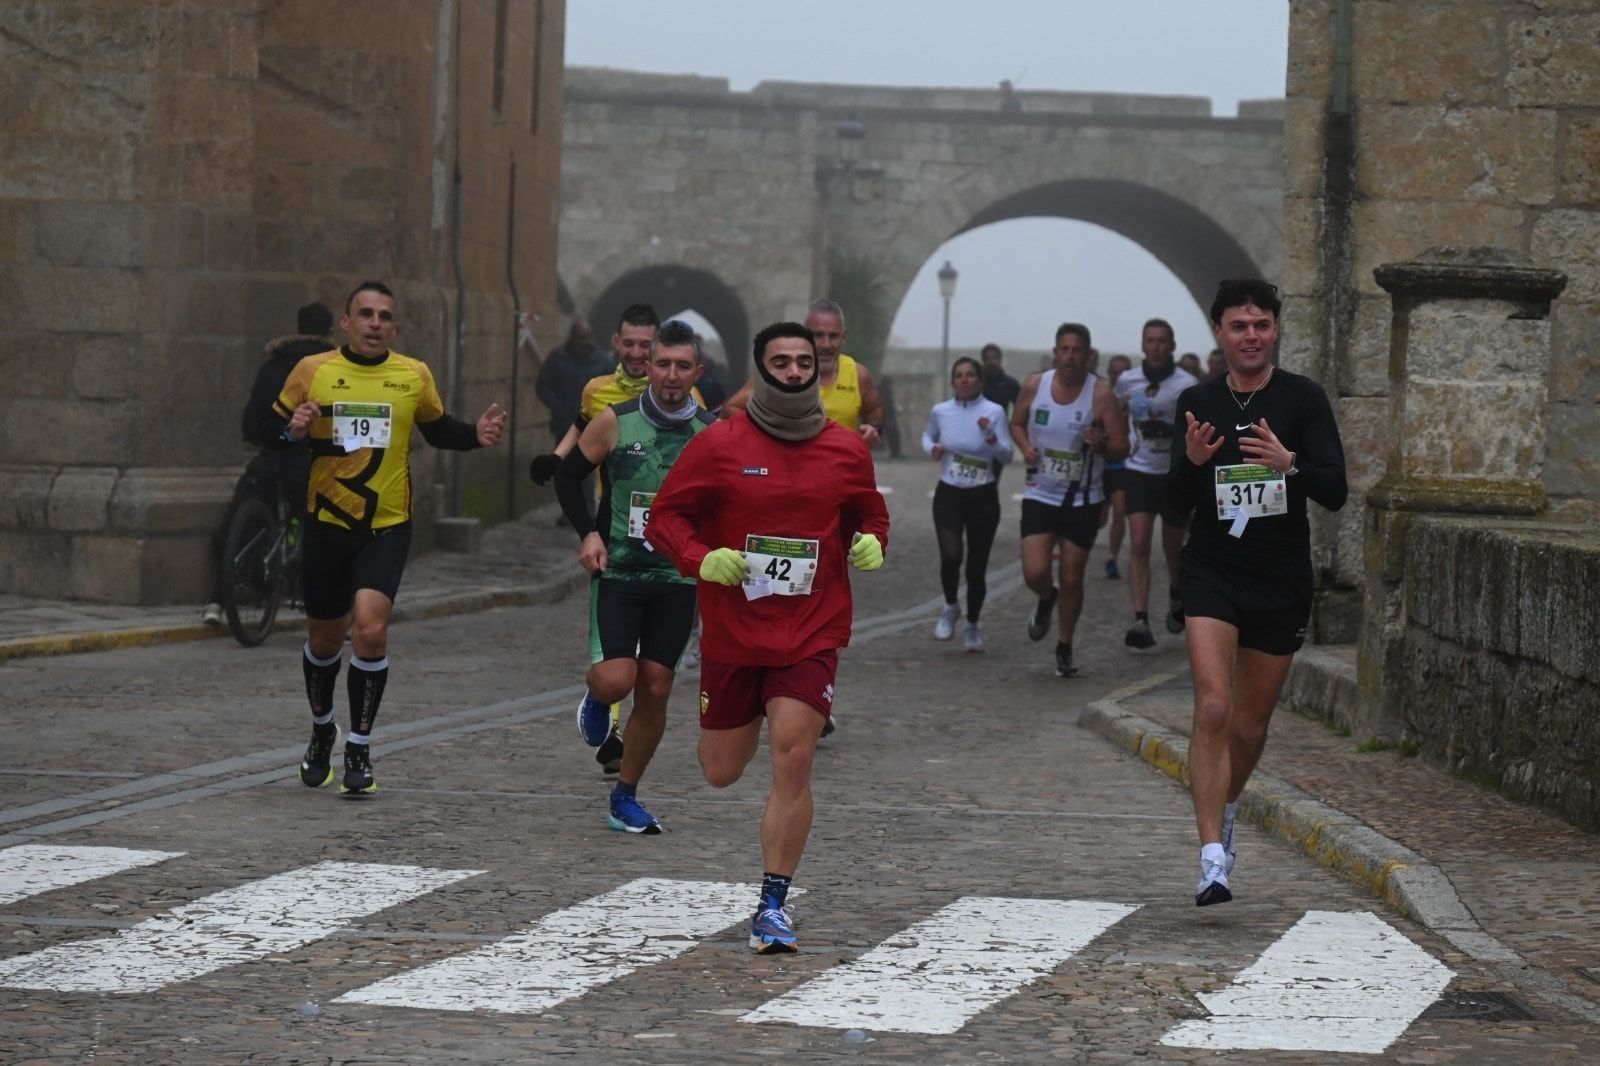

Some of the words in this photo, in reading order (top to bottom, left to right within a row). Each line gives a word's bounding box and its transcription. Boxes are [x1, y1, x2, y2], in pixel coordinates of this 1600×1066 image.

[351, 418, 370, 437] 19
[1050, 459, 1071, 474] 723
[1230, 484, 1266, 506] 317
[764, 557, 792, 581] 42
